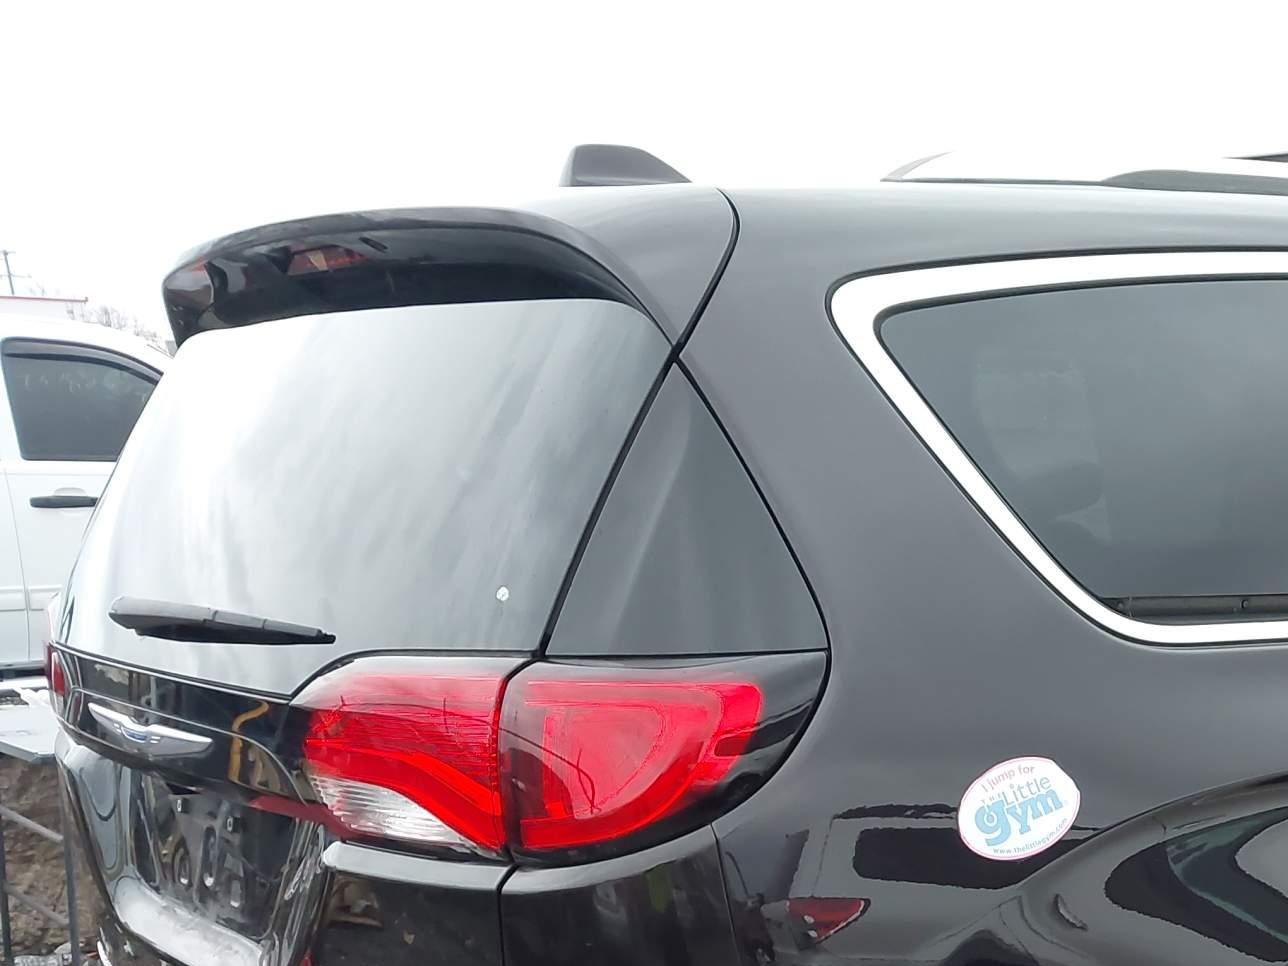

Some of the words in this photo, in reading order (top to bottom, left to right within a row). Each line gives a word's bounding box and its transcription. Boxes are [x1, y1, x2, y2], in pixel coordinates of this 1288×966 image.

[986, 769, 1016, 790] jump
[1017, 764, 1036, 775] for
[1002, 776, 1052, 806] Little
[975, 788, 1064, 847] gym
